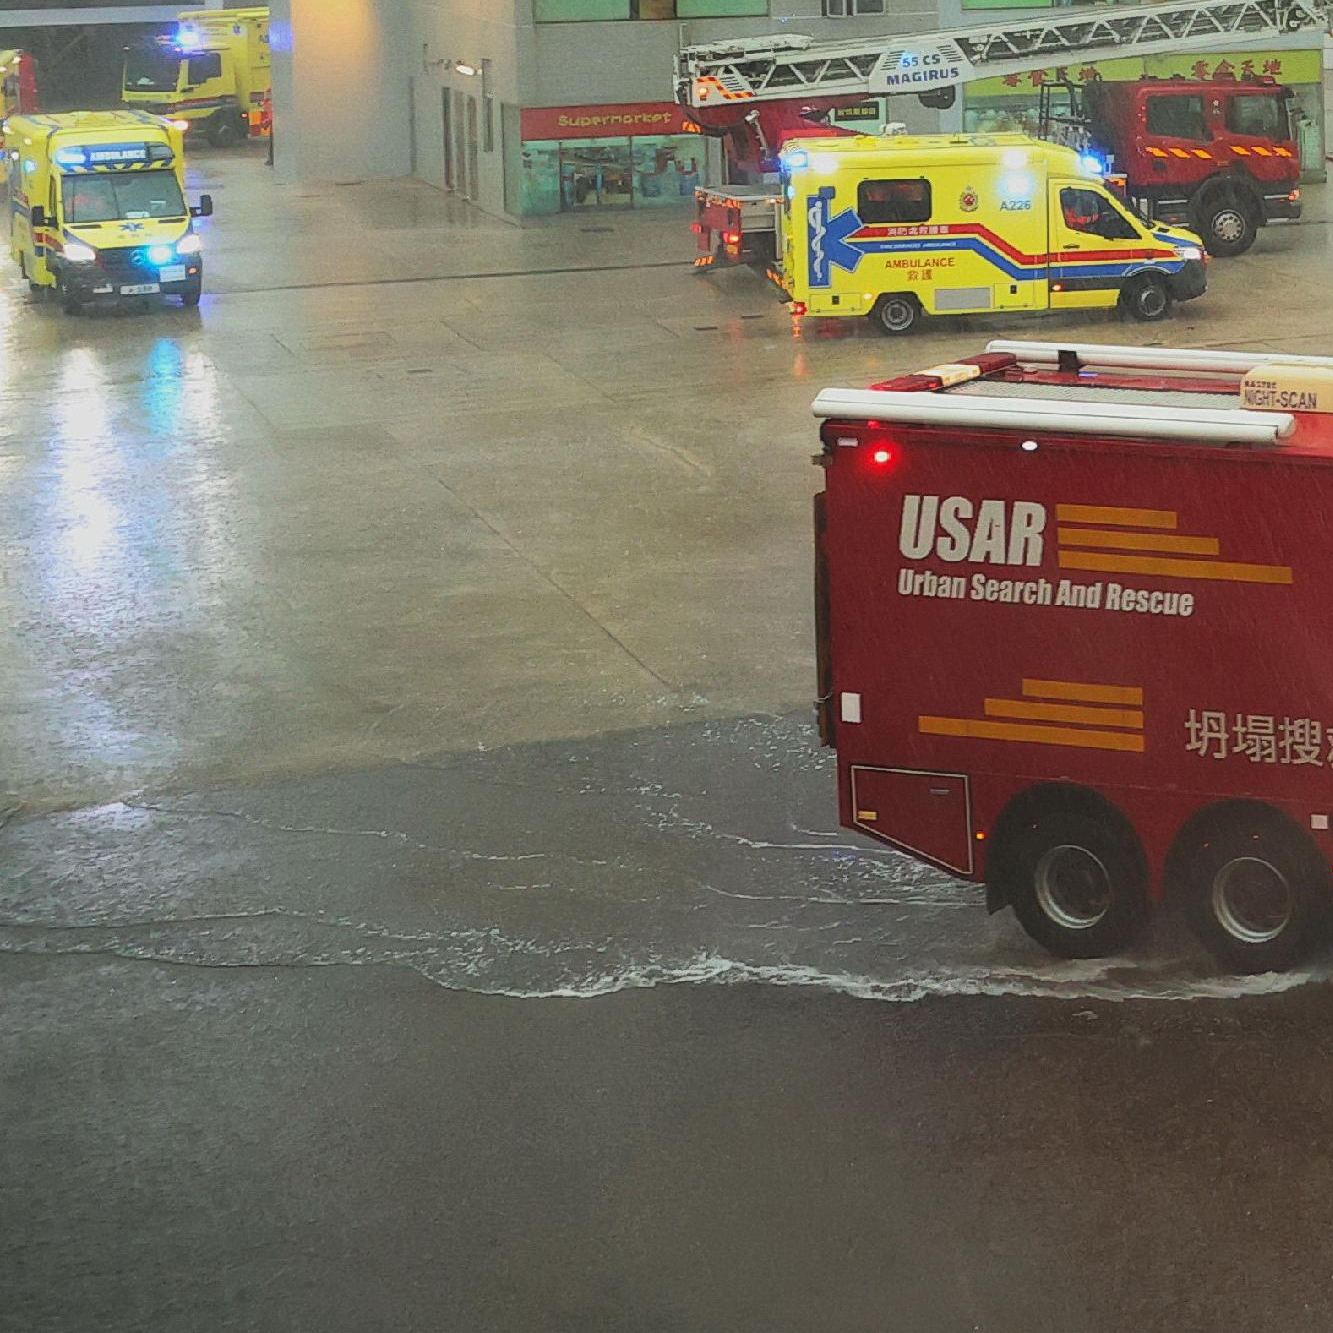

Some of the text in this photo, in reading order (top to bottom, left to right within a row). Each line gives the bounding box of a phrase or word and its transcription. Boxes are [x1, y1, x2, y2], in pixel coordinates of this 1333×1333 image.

[923, 54, 941, 66] CS
[886, 67, 960, 85] MAGIRUS
[558, 112, 673, 128] Supermarket
[999, 200, 1031, 211] A226
[885, 257, 956, 269] AMBULANCE
[1244, 390, 1317, 409] NIGHT-SCAN
[899, 494, 1047, 566] USAR
[898, 568, 1195, 616] Urban Search And Rescue
